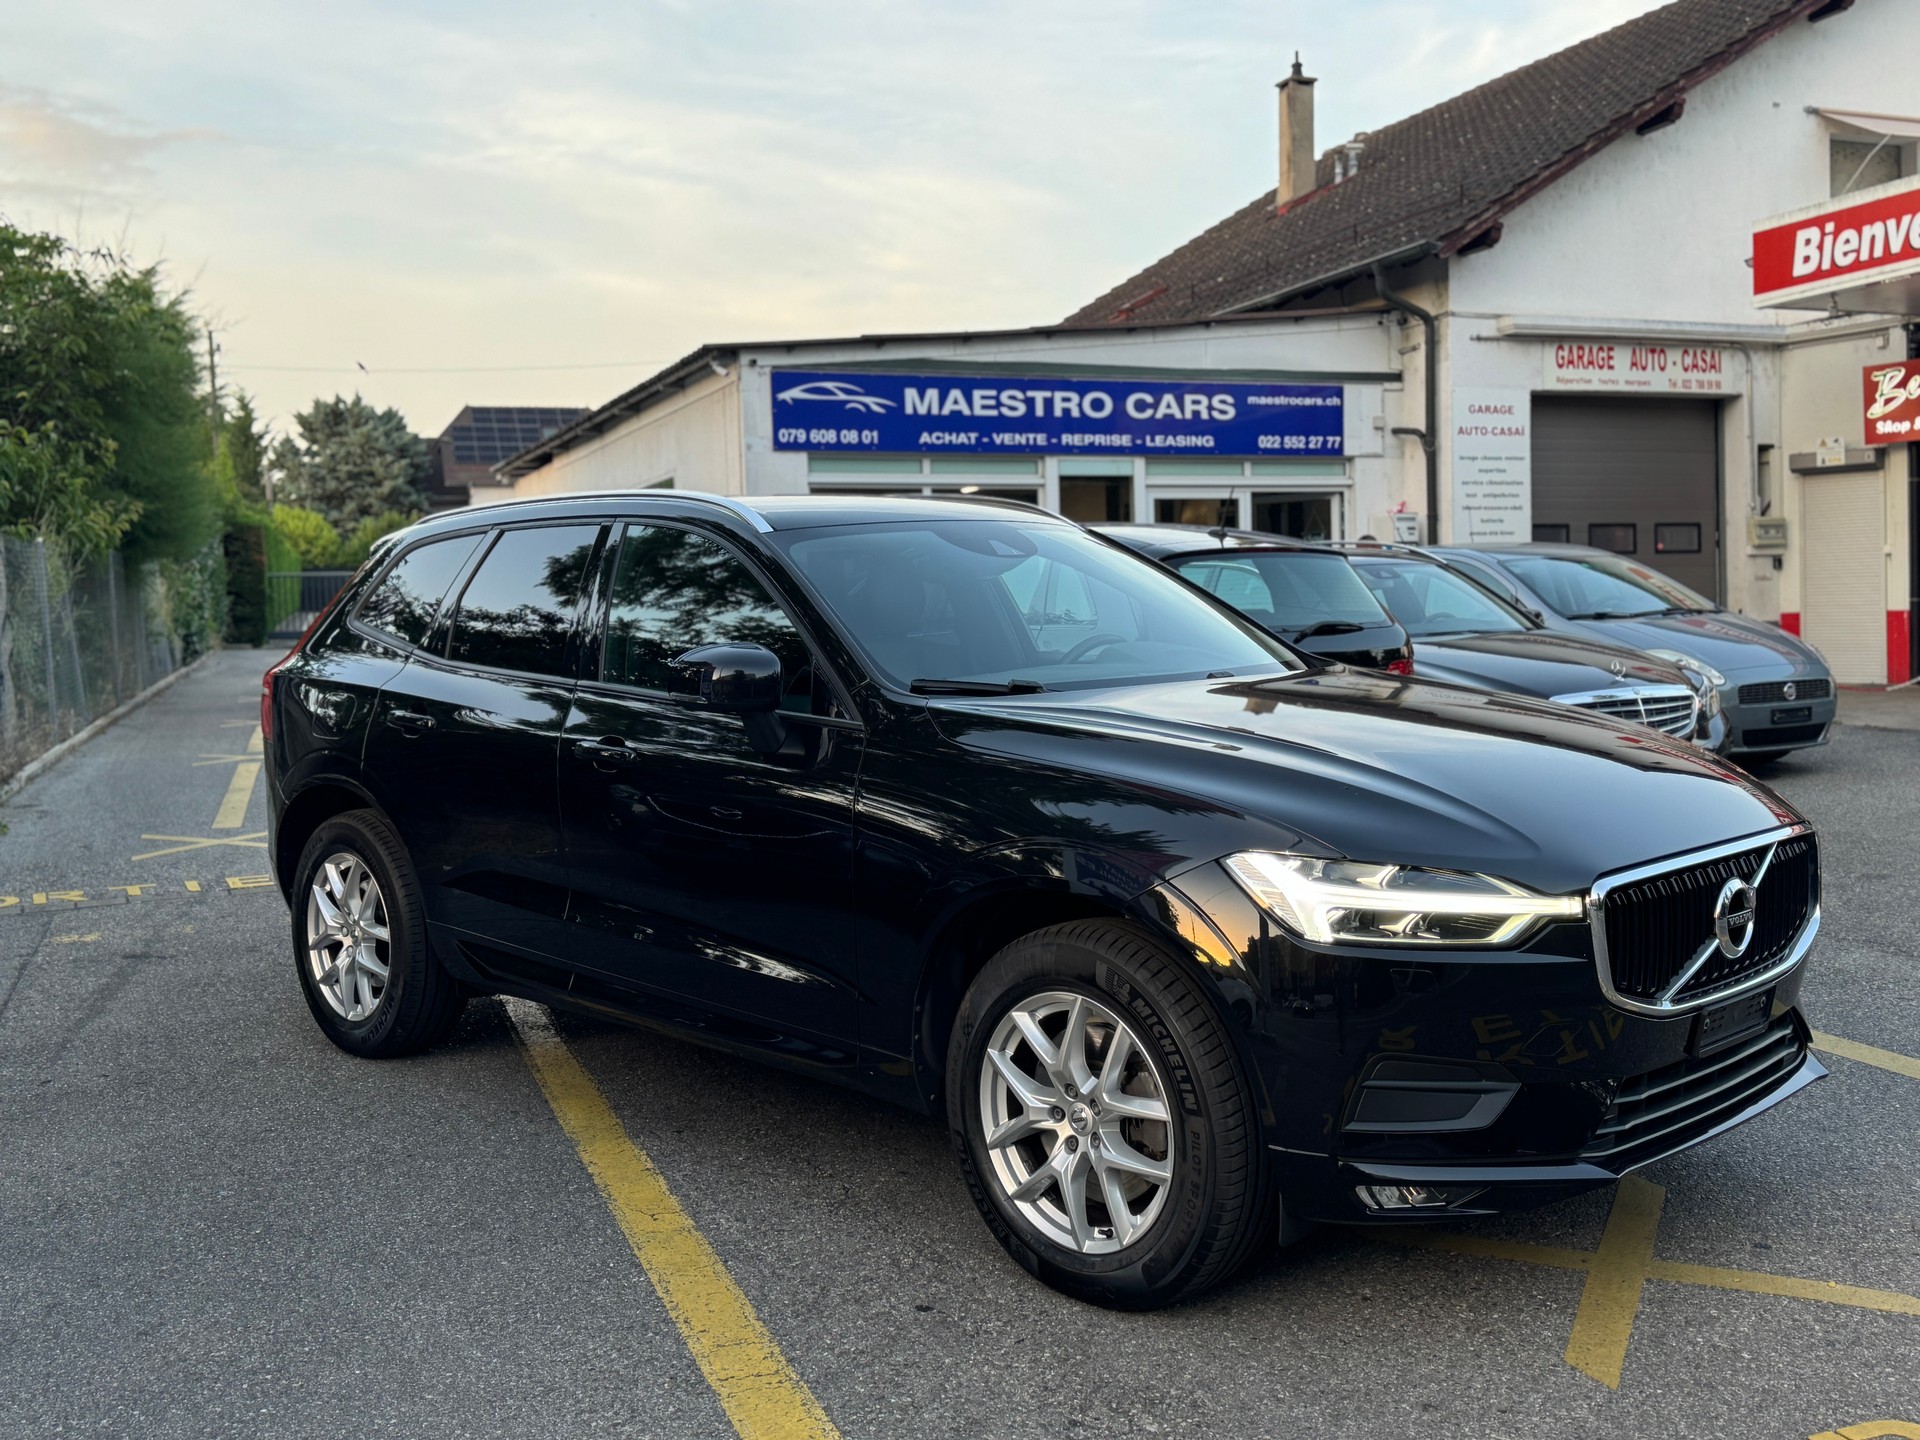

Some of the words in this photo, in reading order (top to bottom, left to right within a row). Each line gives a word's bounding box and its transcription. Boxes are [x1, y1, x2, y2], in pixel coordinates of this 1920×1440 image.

[1555, 344, 1615, 370] GARAGE
[1630, 347, 1667, 372] AUTO
[904, 387, 1114, 419] MAESTRO
[1125, 392, 1237, 421] CARS
[1247, 395, 1342, 407] maestrocars.ch
[1468, 404, 1515, 415] GARAGE
[1876, 420, 1911, 435] Shop
[778, 428, 807, 443] 079
[809, 429, 837, 444] 608
[840, 429, 859, 444] 08
[861, 430, 878, 445] 01
[918, 432, 979, 445] ACHAT
[992, 433, 1048, 445] VENTE
[1061, 434, 1132, 447] REPRISE
[1145, 434, 1215, 447] LEASING
[1258, 435, 1281, 449] 022
[1283, 436, 1306, 449] 552
[1308, 436, 1324, 449] 27
[1326, 436, 1342, 449] 77
[1728, 911, 1753, 926] VOLVO
[1131, 998, 1198, 1110] MICHELIN
[1190, 1129, 1202, 1176] PILOT
